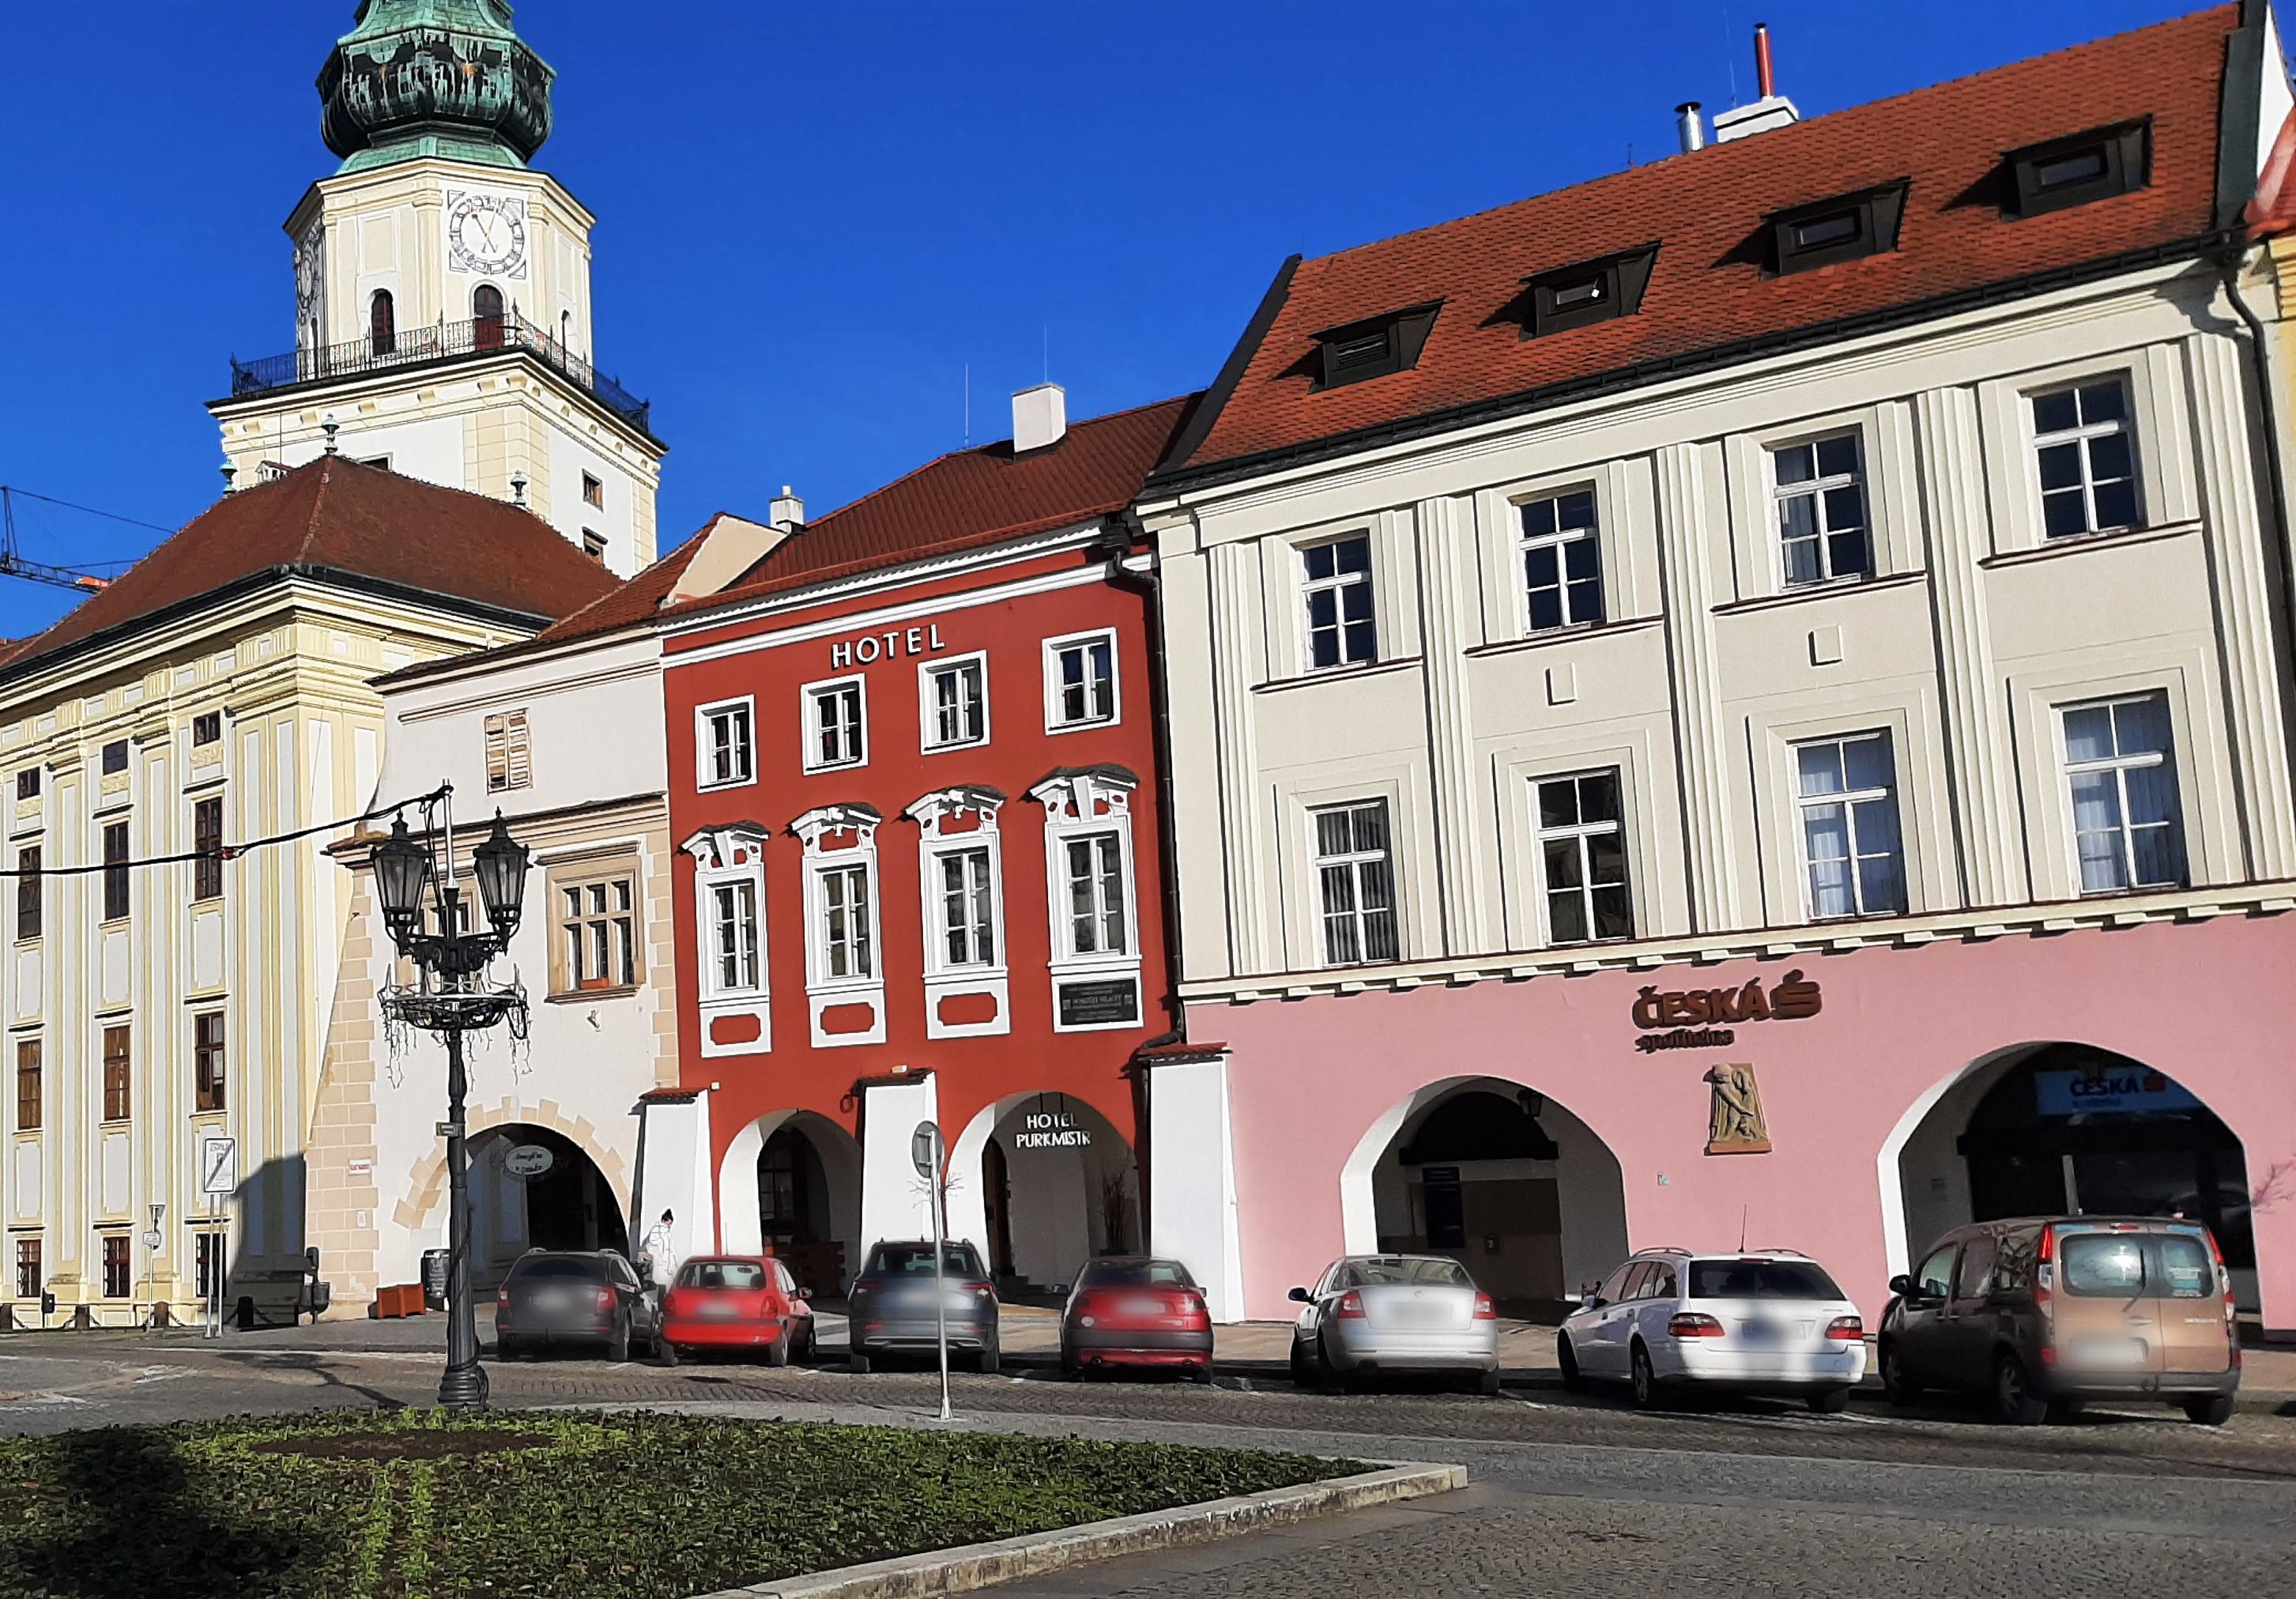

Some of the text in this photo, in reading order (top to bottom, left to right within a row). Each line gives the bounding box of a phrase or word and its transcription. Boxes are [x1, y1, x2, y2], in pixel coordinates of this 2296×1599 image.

[831, 624, 945, 669] HOTEL
[1633, 977, 1771, 1029] ČESKÁ
[1026, 1113, 1078, 1129] HOTEL
[1016, 1130, 1091, 1148] PURKMISTR
